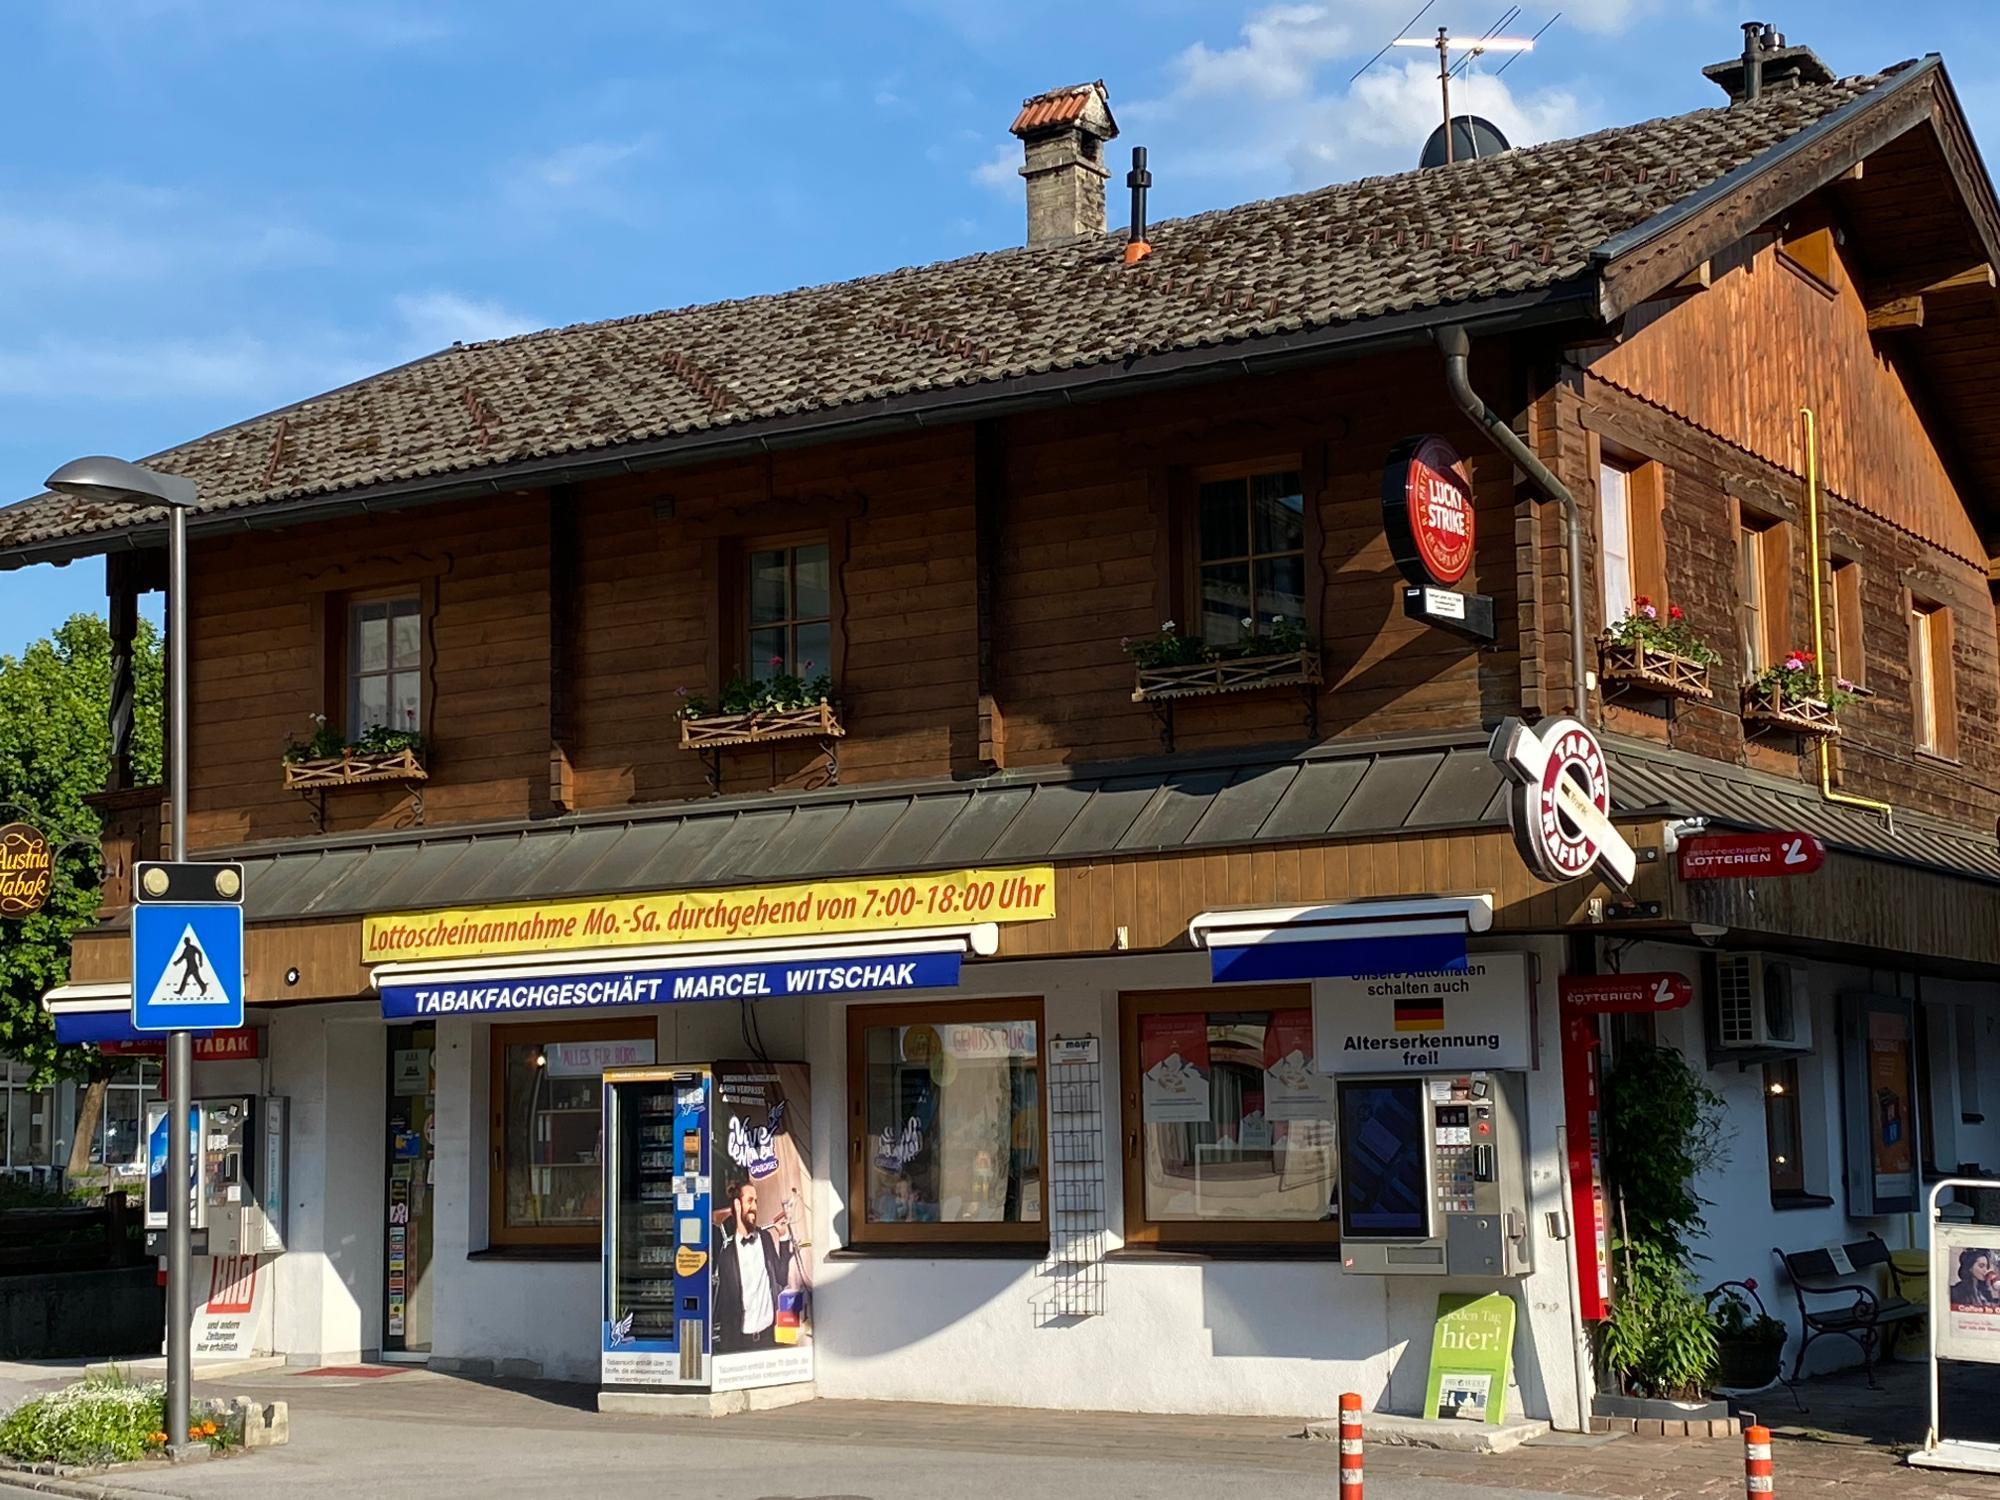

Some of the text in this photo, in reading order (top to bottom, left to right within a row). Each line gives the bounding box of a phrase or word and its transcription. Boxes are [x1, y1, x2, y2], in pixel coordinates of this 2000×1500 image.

[1428, 478, 1463, 511] LUCKY
[1428, 503, 1465, 538] STRIKE
[1555, 734, 1605, 797] TABAK
[1542, 787, 1590, 867] TRAFIK
[1686, 853, 1772, 866] LOTTERIEN
[369, 876, 1046, 952] Lottoscheinannahme Mo.-Sa. durchgehend von 7:00-18:00 Uhr
[415, 962, 916, 1014] TABAKFACHGESCHÄFT MARCEL WITSCHAK
[1367, 979, 1469, 995] schalten auch
[1567, 992, 1643, 1003] LOTTERIEN
[194, 1037, 249, 1054] TABAK
[1066, 1041, 1091, 1050] mayr
[1344, 1033, 1499, 1050] Alterserkennung
[1403, 1050, 1439, 1066] frei!
[1958, 1304, 1984, 1312] Coffee
[1482, 1311, 1502, 1325] Tag
[1440, 1323, 1502, 1351] hier!
